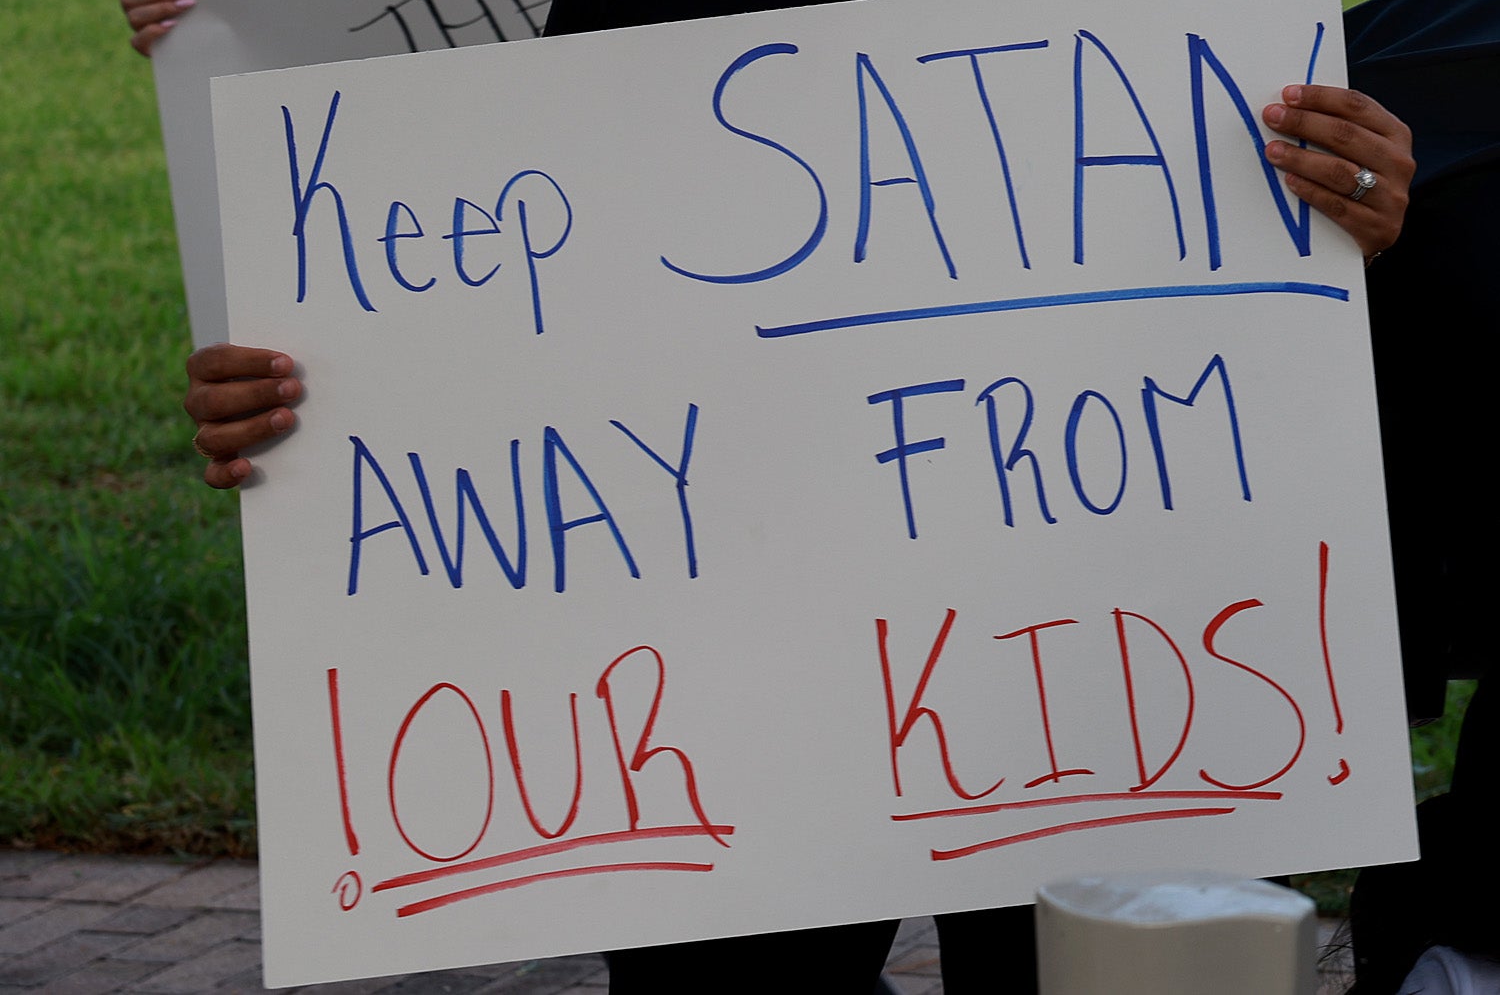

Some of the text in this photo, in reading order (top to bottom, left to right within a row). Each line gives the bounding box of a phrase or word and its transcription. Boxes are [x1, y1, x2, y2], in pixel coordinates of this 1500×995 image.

[280, 21, 1323, 336] Keep SATAN
[347, 352, 1253, 597] AWAY FROM
[873, 539, 1351, 802] KIDS!
